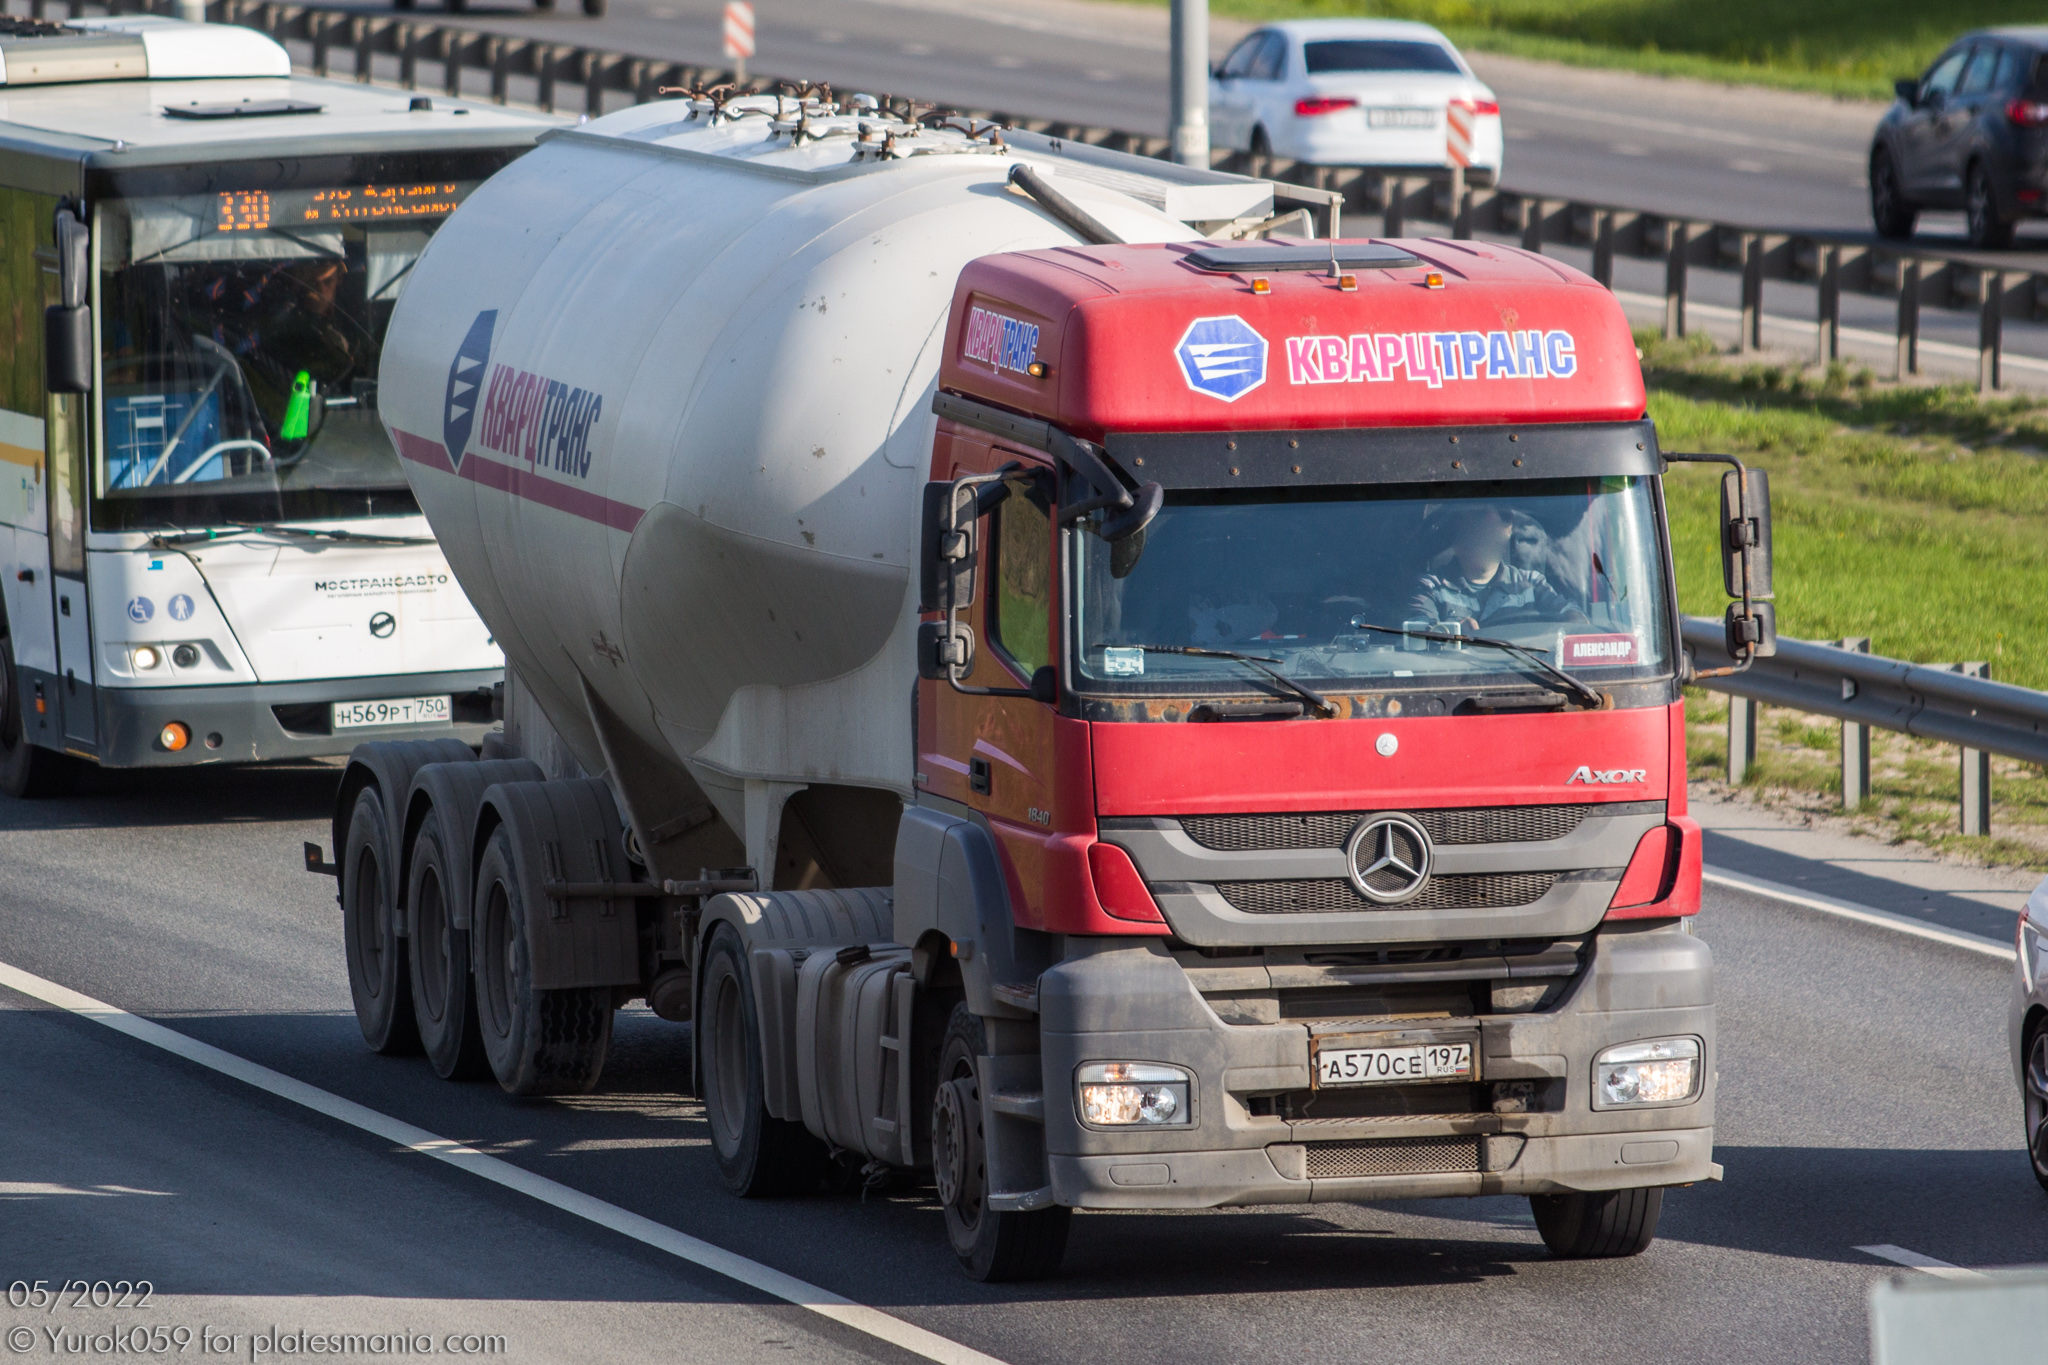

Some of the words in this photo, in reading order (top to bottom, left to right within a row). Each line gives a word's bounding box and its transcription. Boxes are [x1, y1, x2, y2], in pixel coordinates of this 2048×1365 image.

[965, 306, 1040, 375] КВАРЦТРАНС
[1285, 330, 1578, 388] КВАРЦТРАНС
[480, 363, 603, 479] КВАРЦТРАНС
[315, 574, 448, 591] МОСТРАНСАВТО
[1573, 641, 1632, 658] АЛЕКСАНДР
[416, 699, 444, 714] 750
[1028, 807, 1050, 826] 1840
[1428, 1047, 1465, 1066] 197
